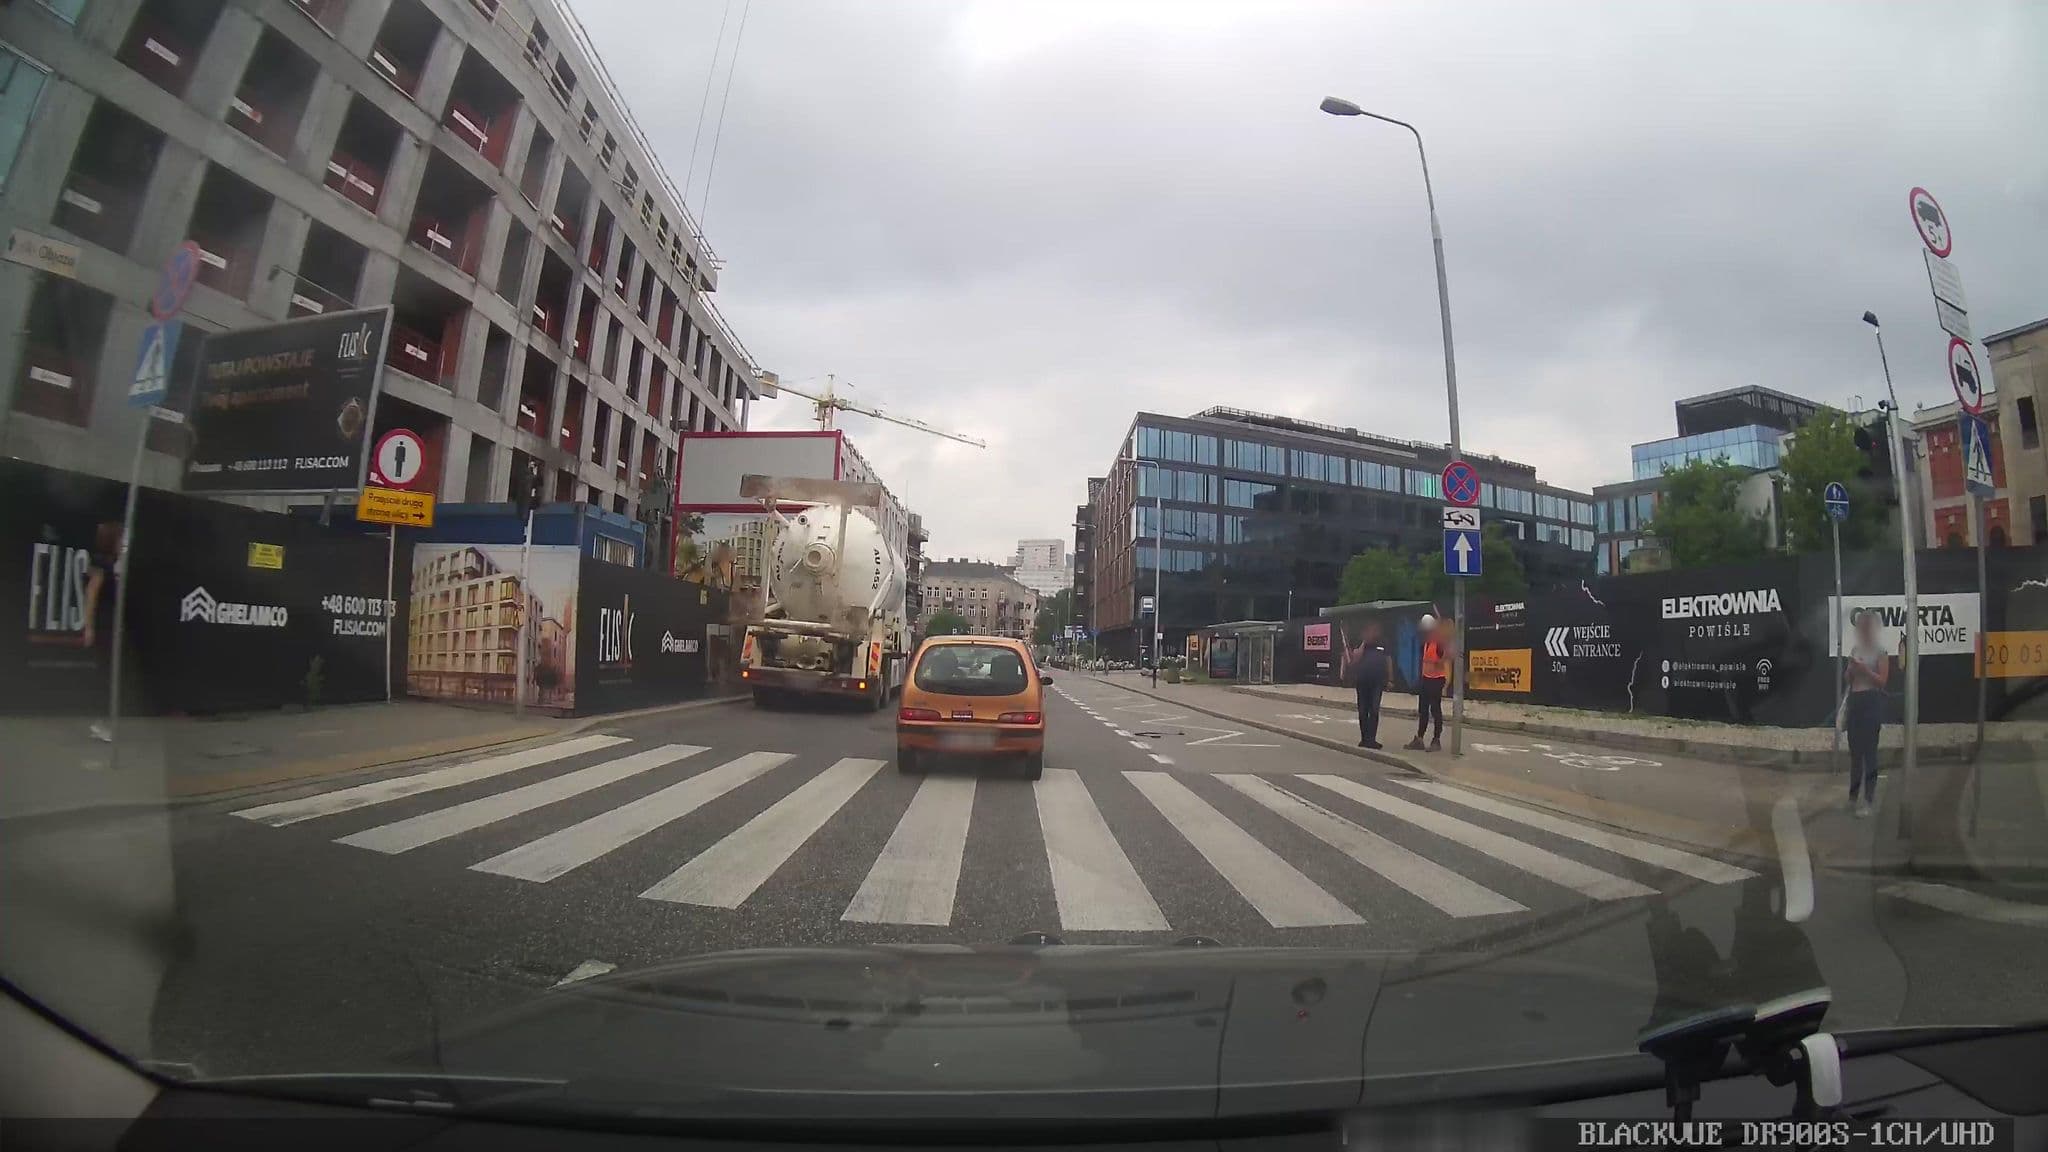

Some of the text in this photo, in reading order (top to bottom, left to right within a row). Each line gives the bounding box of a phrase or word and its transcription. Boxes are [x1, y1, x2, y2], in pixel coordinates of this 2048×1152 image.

[29, 542, 92, 631] FLIS
[321, 594, 342, 613] +48
[344, 596, 366, 614] 600
[368, 598, 382, 616] 113
[1662, 588, 1782, 619] ELEKTROWNIA
[217, 602, 288, 626] GHELAMCO
[333, 618, 386, 637] FLISAC.COM
[1573, 622, 1610, 641] WEJŚCIE
[1689, 621, 1750, 638] POWIŚLE
[1924, 627, 1967, 643] NOWE
[1573, 644, 1621, 657] ENTRANCE
